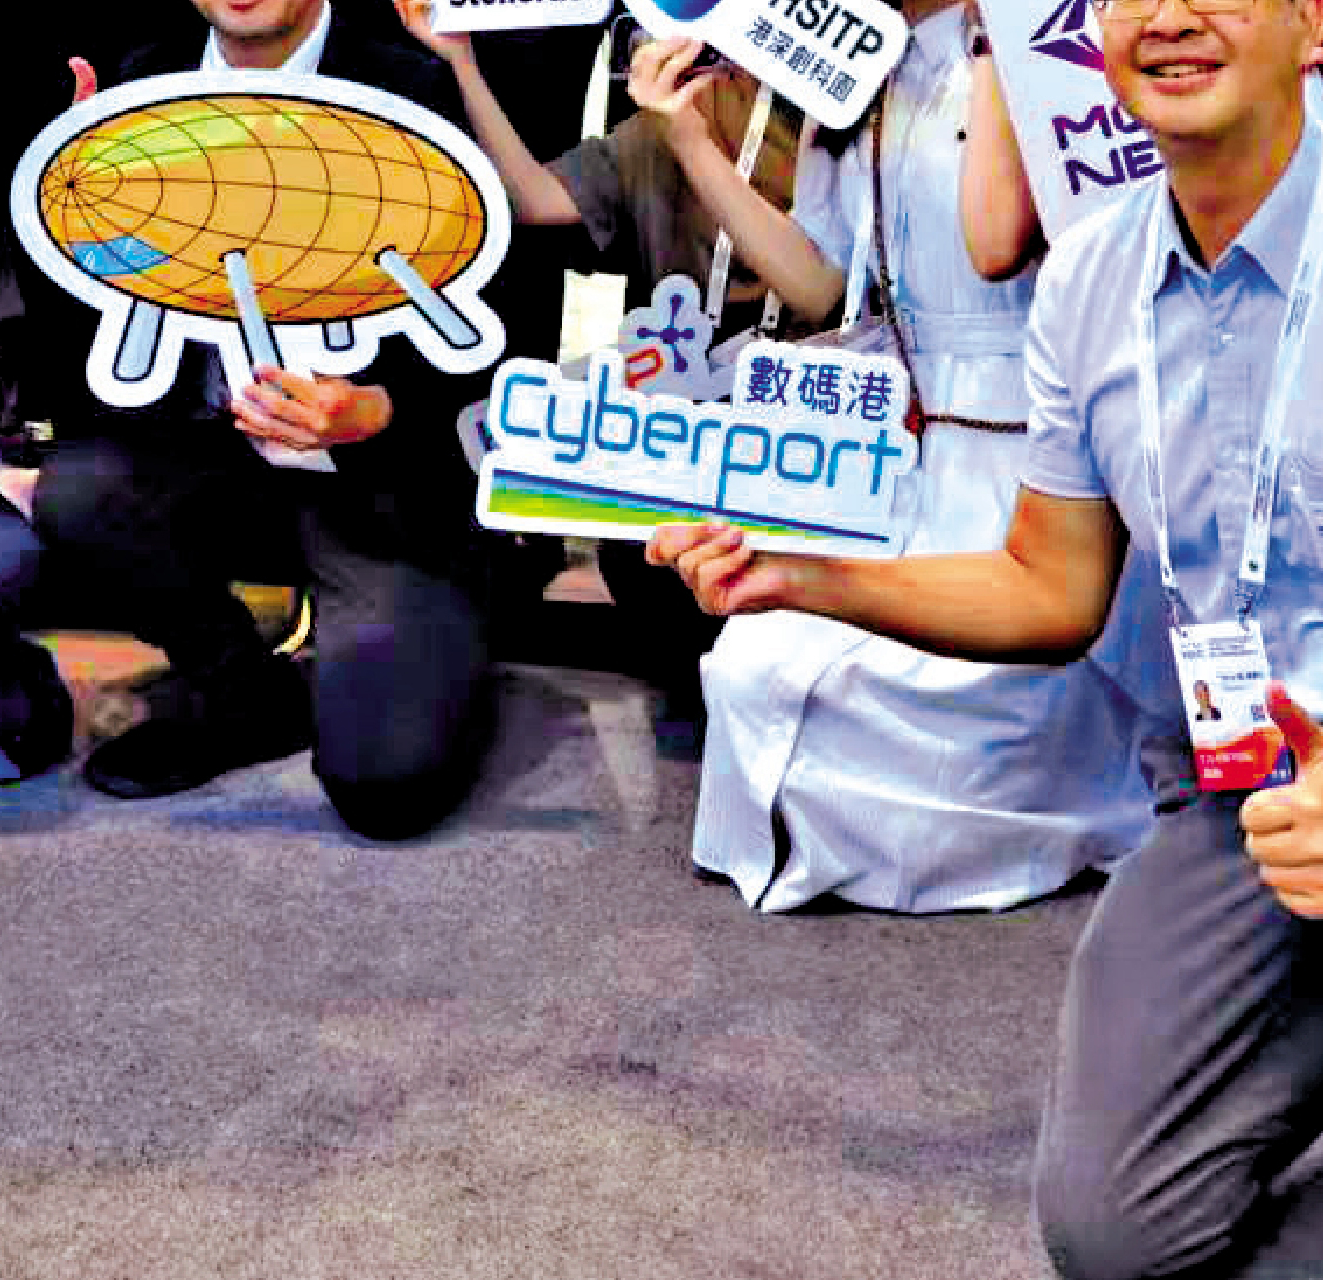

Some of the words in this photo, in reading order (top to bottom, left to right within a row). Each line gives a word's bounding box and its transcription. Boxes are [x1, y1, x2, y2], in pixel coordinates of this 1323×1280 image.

[746, 15, 858, 104] 港深創科園
[746, 356, 891, 422] 數碼港
[499, 363, 903, 510] Cyberport
